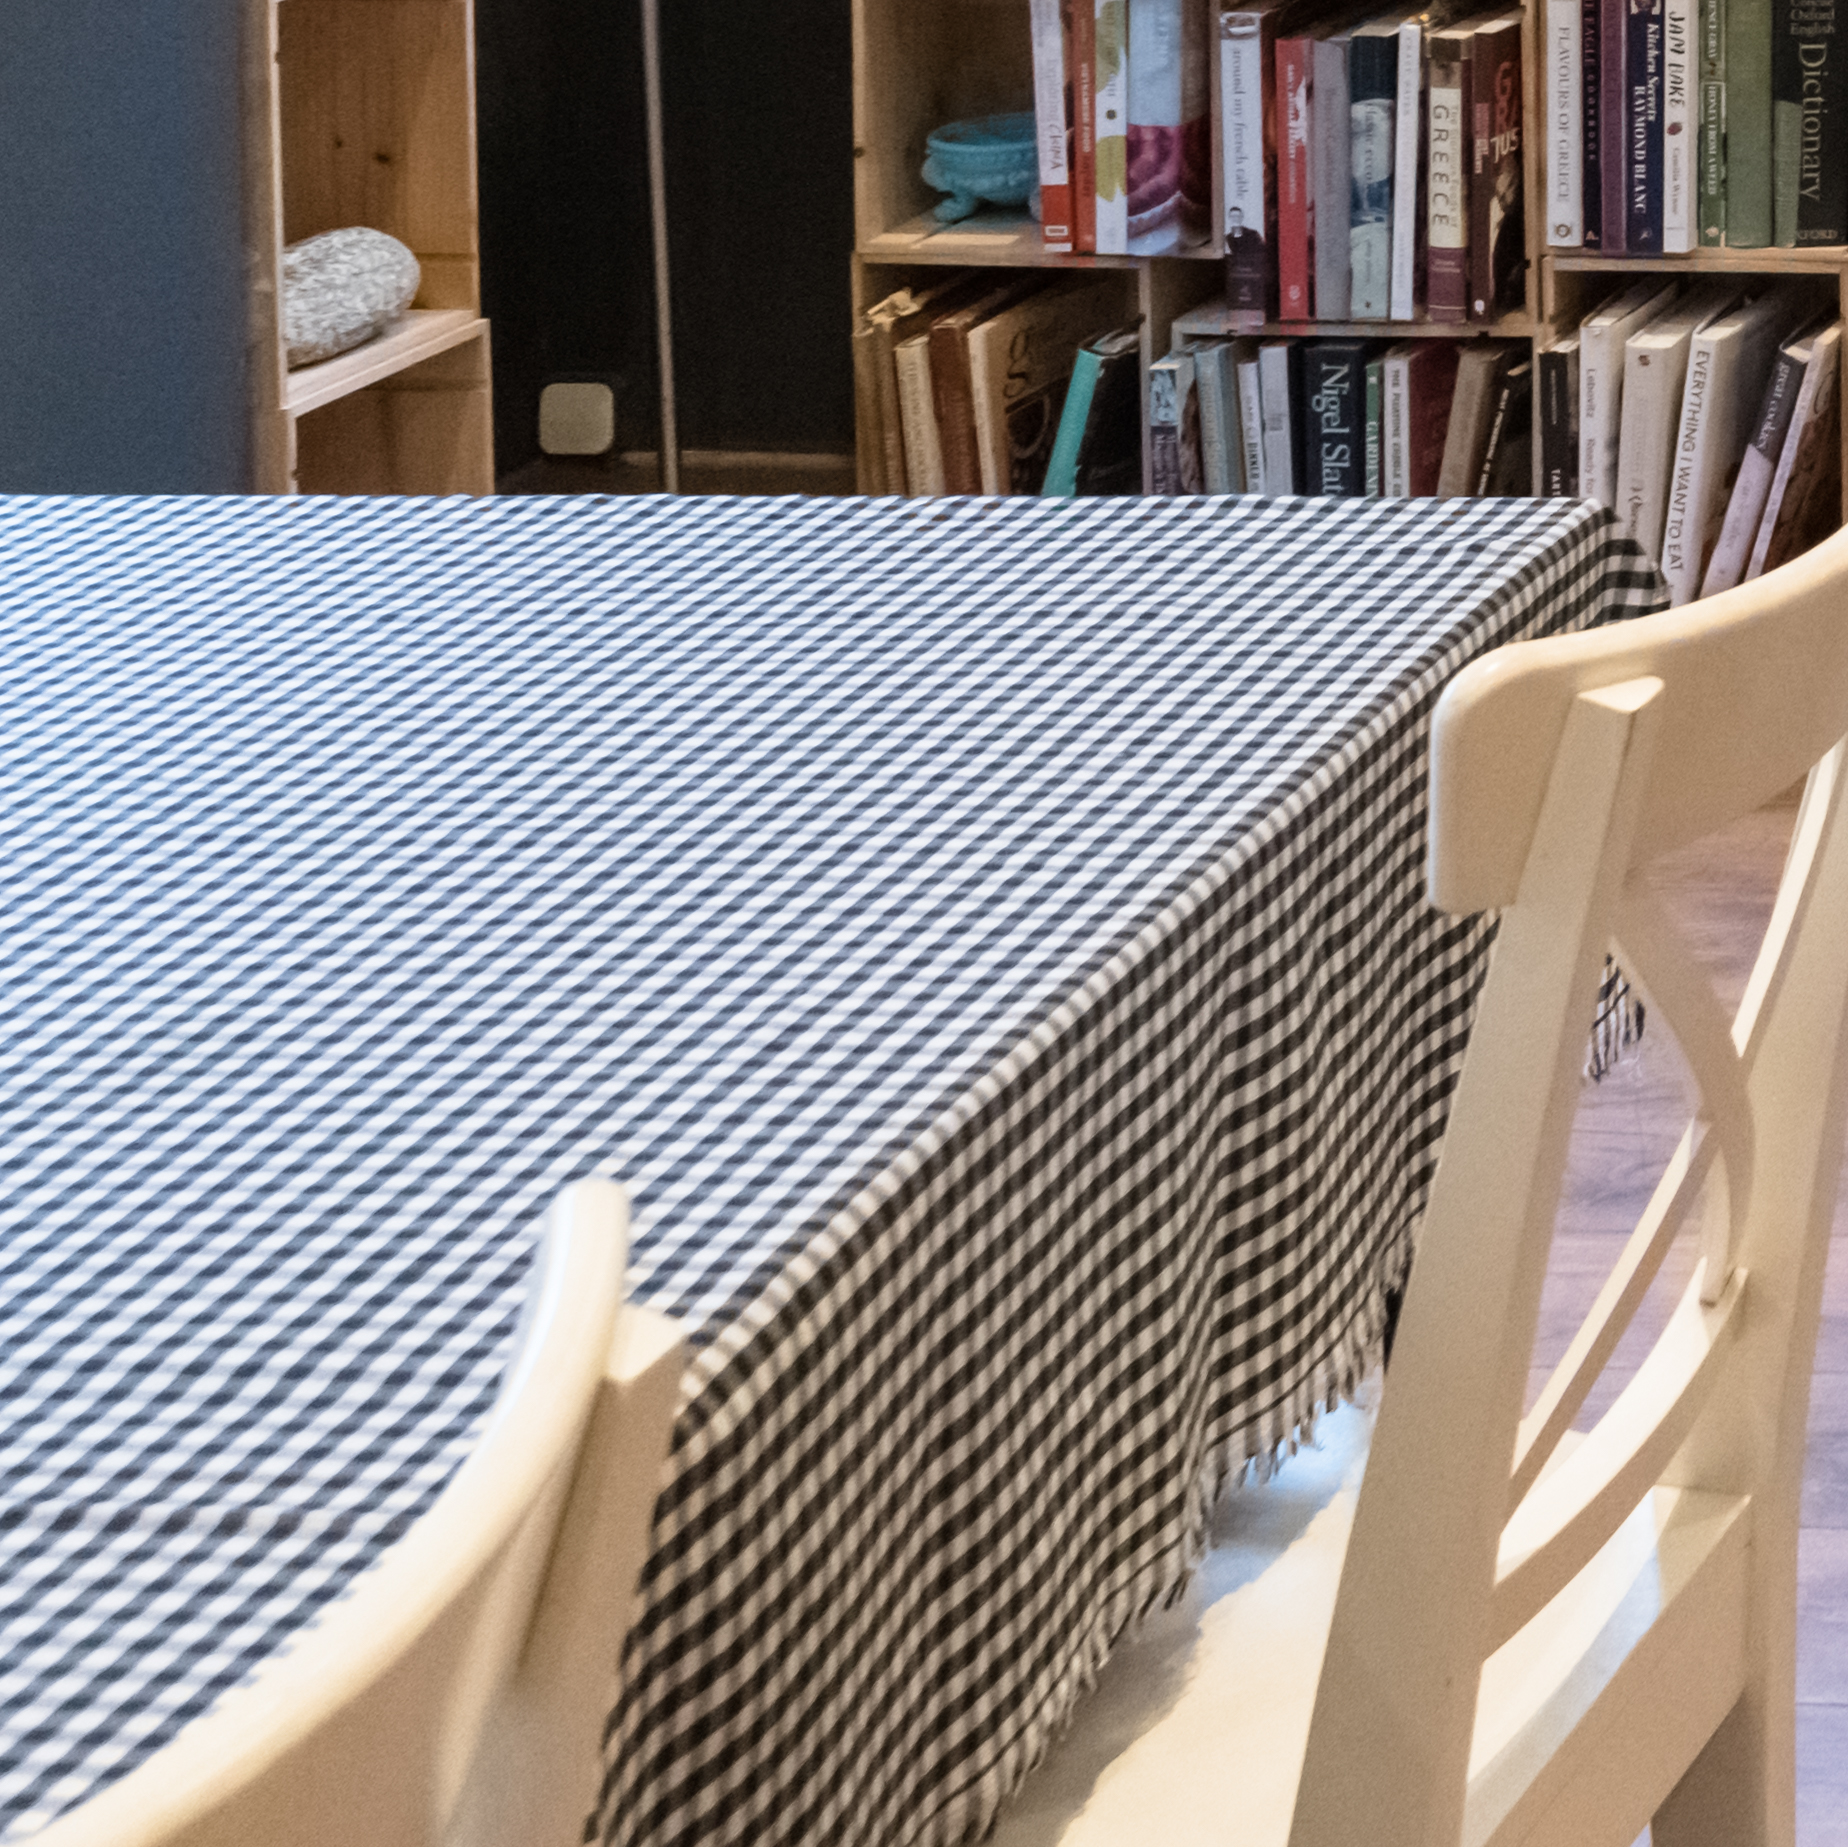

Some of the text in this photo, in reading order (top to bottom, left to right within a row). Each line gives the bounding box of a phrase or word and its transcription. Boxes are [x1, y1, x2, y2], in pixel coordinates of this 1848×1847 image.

[1790, 8, 1835, 20] Oxford
[1790, 22, 1835, 37] English
[1584, 16, 1596, 66] EAGLE
[1668, 11, 1686, 109] JAM BAKE
[1707, 31, 1720, 59] GRAY
[1646, 23, 1660, 122] Kitchen Secrets
[1230, 47, 1249, 200] around my french table
[1450, 104, 1459, 125] The
[1556, 26, 1571, 203] FLAVOURS OF GREECE
[1587, 74, 1597, 161] COOKBOOK
[1707, 85, 1720, 121] HONEY
[1798, 43, 1829, 201] Dictionary
[1048, 123, 1064, 171] CHINA
[1082, 126, 1091, 153] FOOD
[1634, 85, 1647, 214] RAYMOND BLANC
[1707, 123, 1720, 153] FROM
[1432, 104, 1450, 227] GREECE
[1707, 163, 1720, 195] WEED
[1310, 362, 1350, 433] Nigel
[1392, 368, 1401, 388] THE
[1682, 349, 1711, 452] EVERYTHING
[1585, 368, 1597, 494] Lebovitz Ready for
[1756, 363, 1793, 450] great cookies
[1671, 465, 1692, 514] WANT
[1669, 518, 1685, 539] TO
[1667, 543, 1685, 571] EAT
